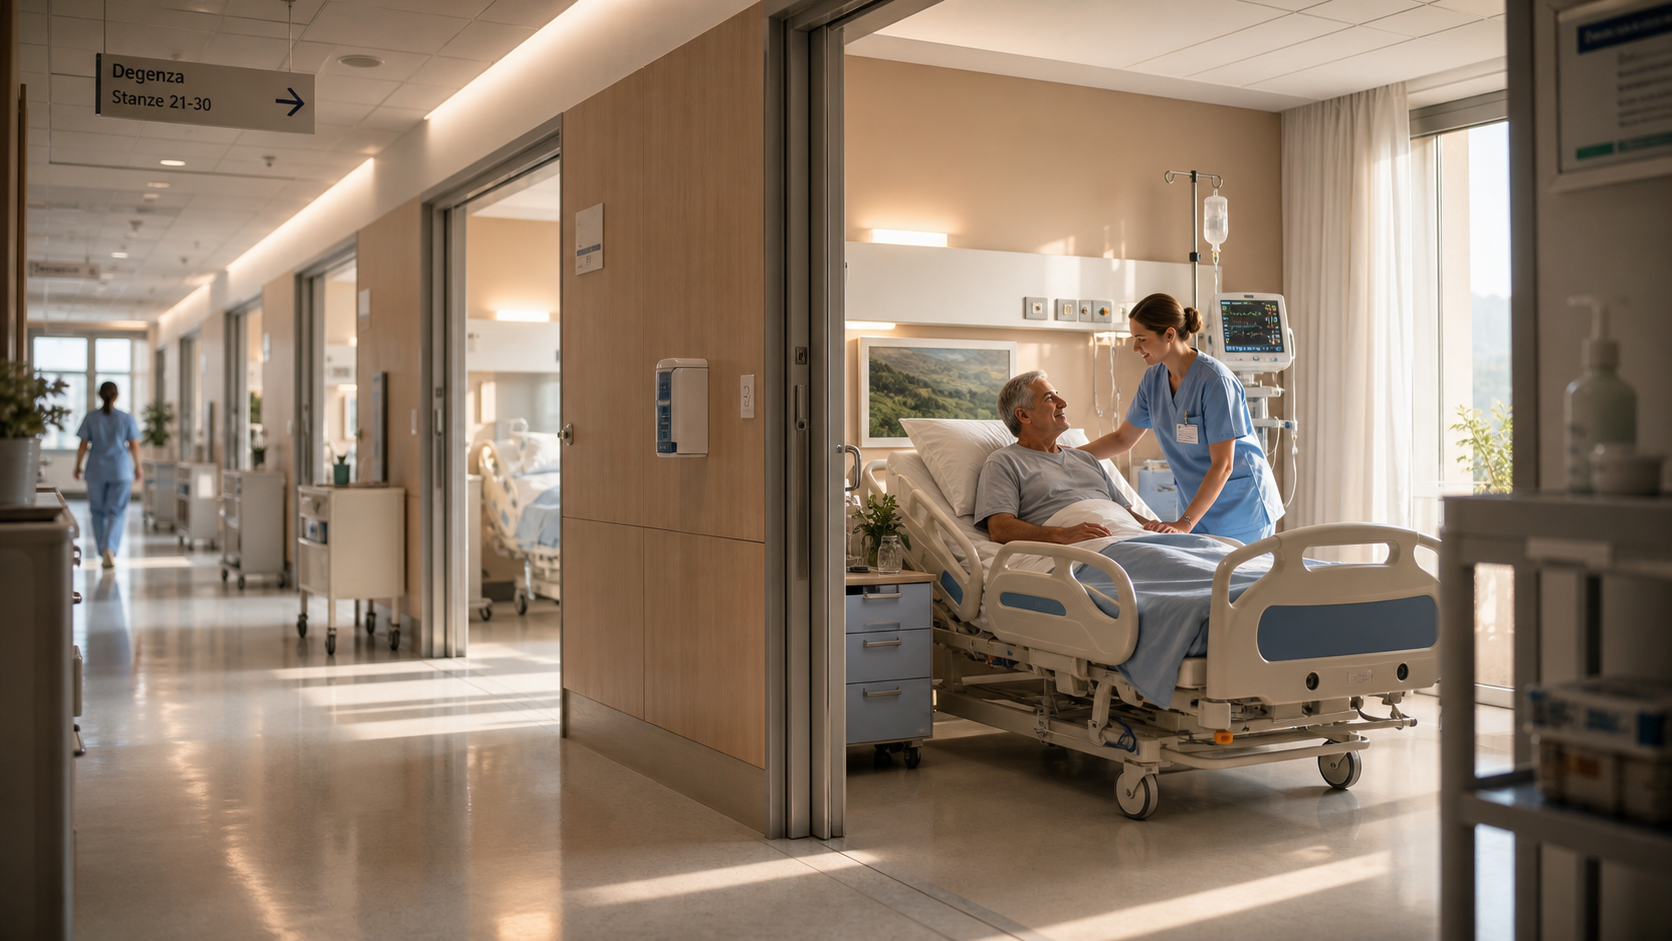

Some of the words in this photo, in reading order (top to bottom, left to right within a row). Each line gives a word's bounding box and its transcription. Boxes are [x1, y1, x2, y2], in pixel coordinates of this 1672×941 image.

[112, 63, 185, 84] Degenza
[112, 90, 165, 107] Stanze
[169, 95, 211, 111] 21-30
